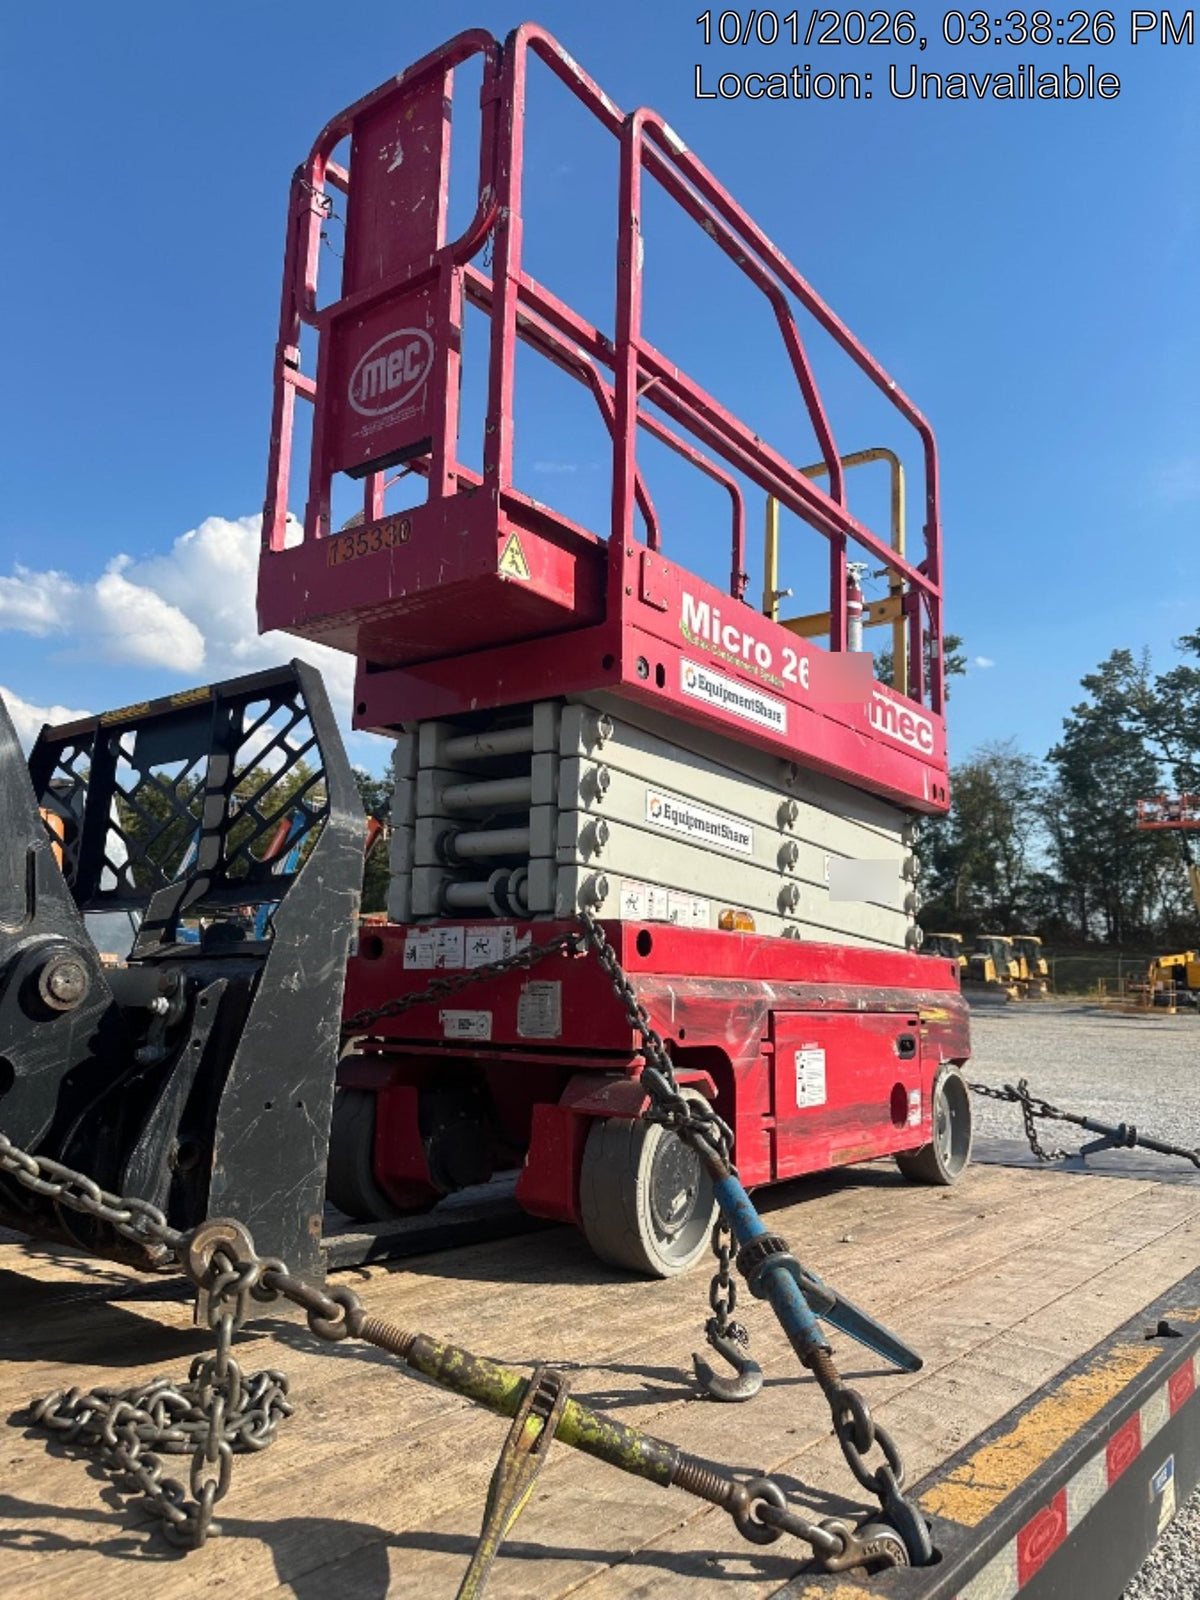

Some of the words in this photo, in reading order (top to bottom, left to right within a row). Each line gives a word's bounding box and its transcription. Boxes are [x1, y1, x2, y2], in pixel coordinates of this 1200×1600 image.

[682, 591, 773, 669] Micro
[697, 672, 782, 724] EquipmentShare
[870, 697, 933, 749] mec
[663, 802, 750, 846] EquipmentShare
